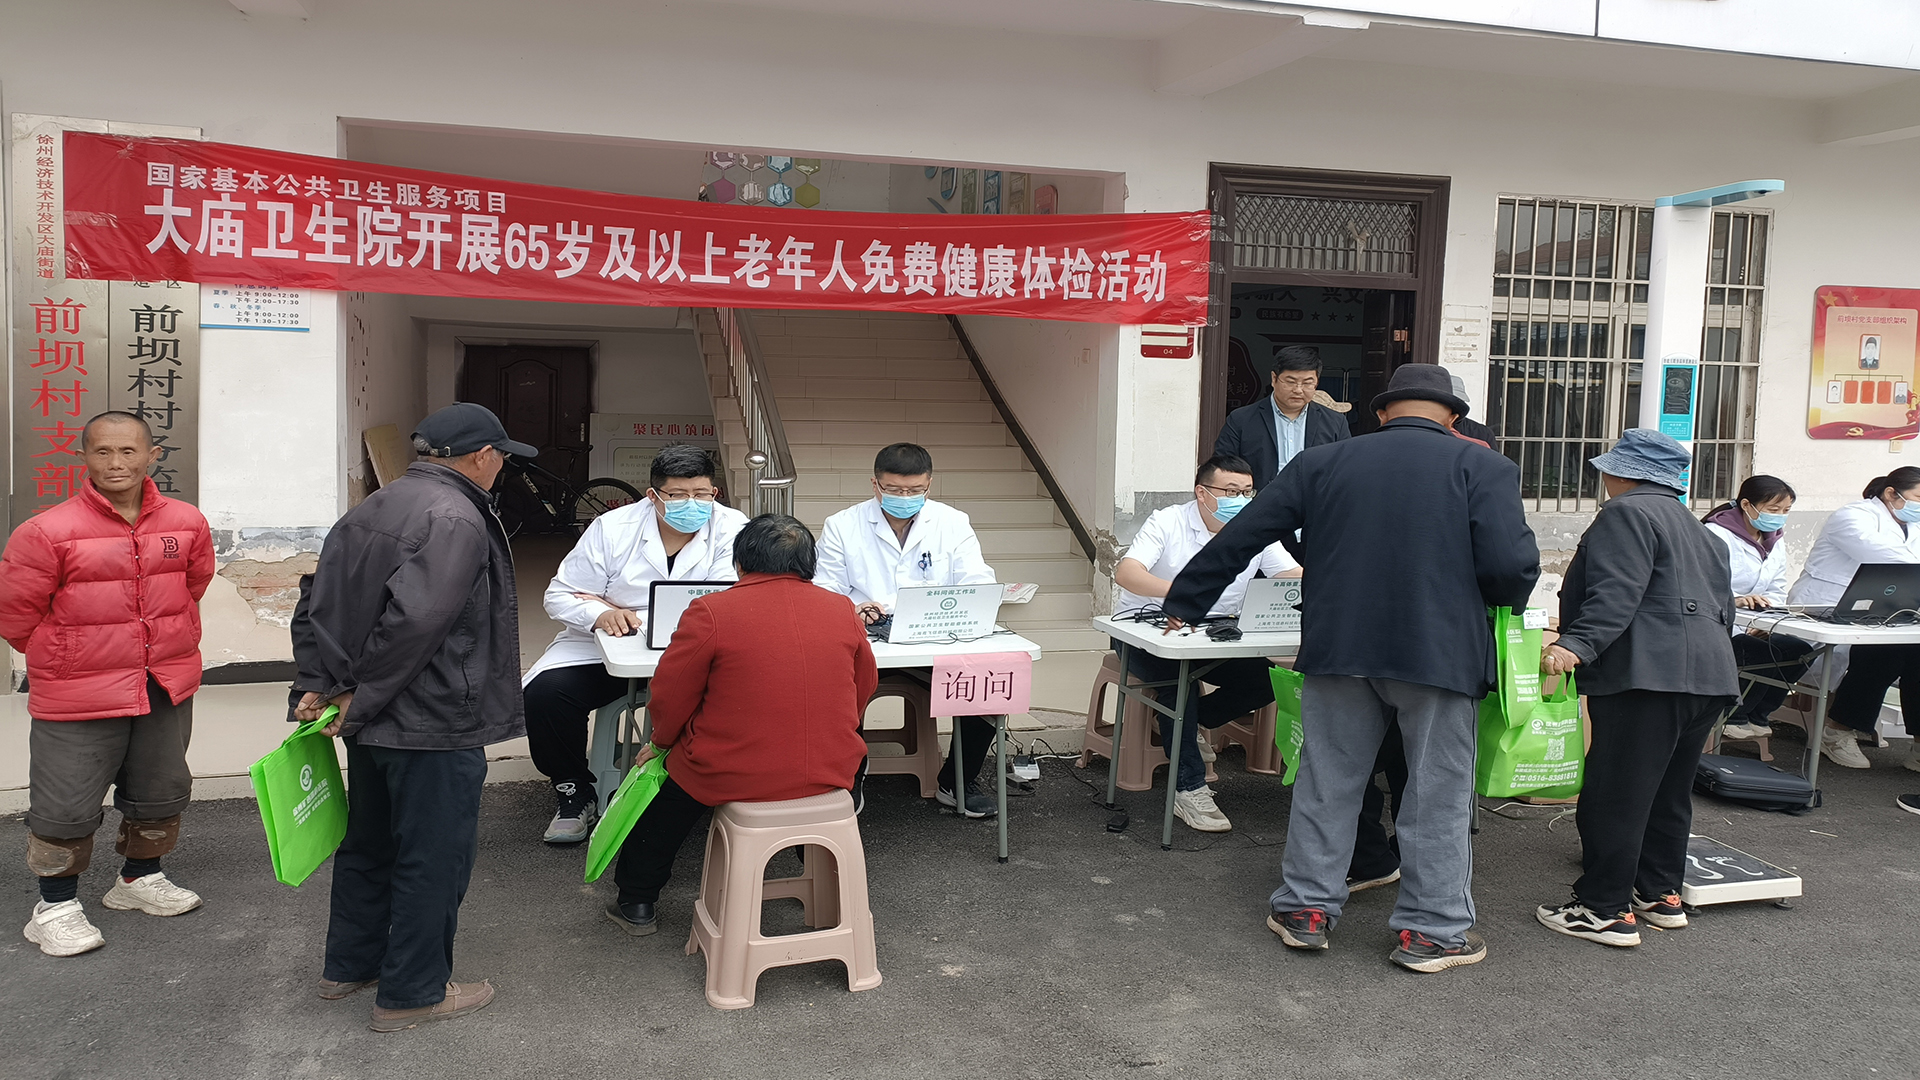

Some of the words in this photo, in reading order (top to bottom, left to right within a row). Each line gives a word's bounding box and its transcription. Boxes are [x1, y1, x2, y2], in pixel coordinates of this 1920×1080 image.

[36, 134, 54, 279] 徐州经济技术开发区大庙街道
[146, 161, 508, 215] 国家基本公共卫生服务项目
[143, 188, 1168, 304] 大庙卫生院开展65岁及以上老年人免费健康体检活动
[1261, 309, 1300, 320] 民族有希望
[1837, 315, 1907, 324] 前坝村党支部组织架构
[28, 297, 90, 514] 前坝村支部
[160, 536, 179, 554] B
[940, 670, 1015, 704] 询问
